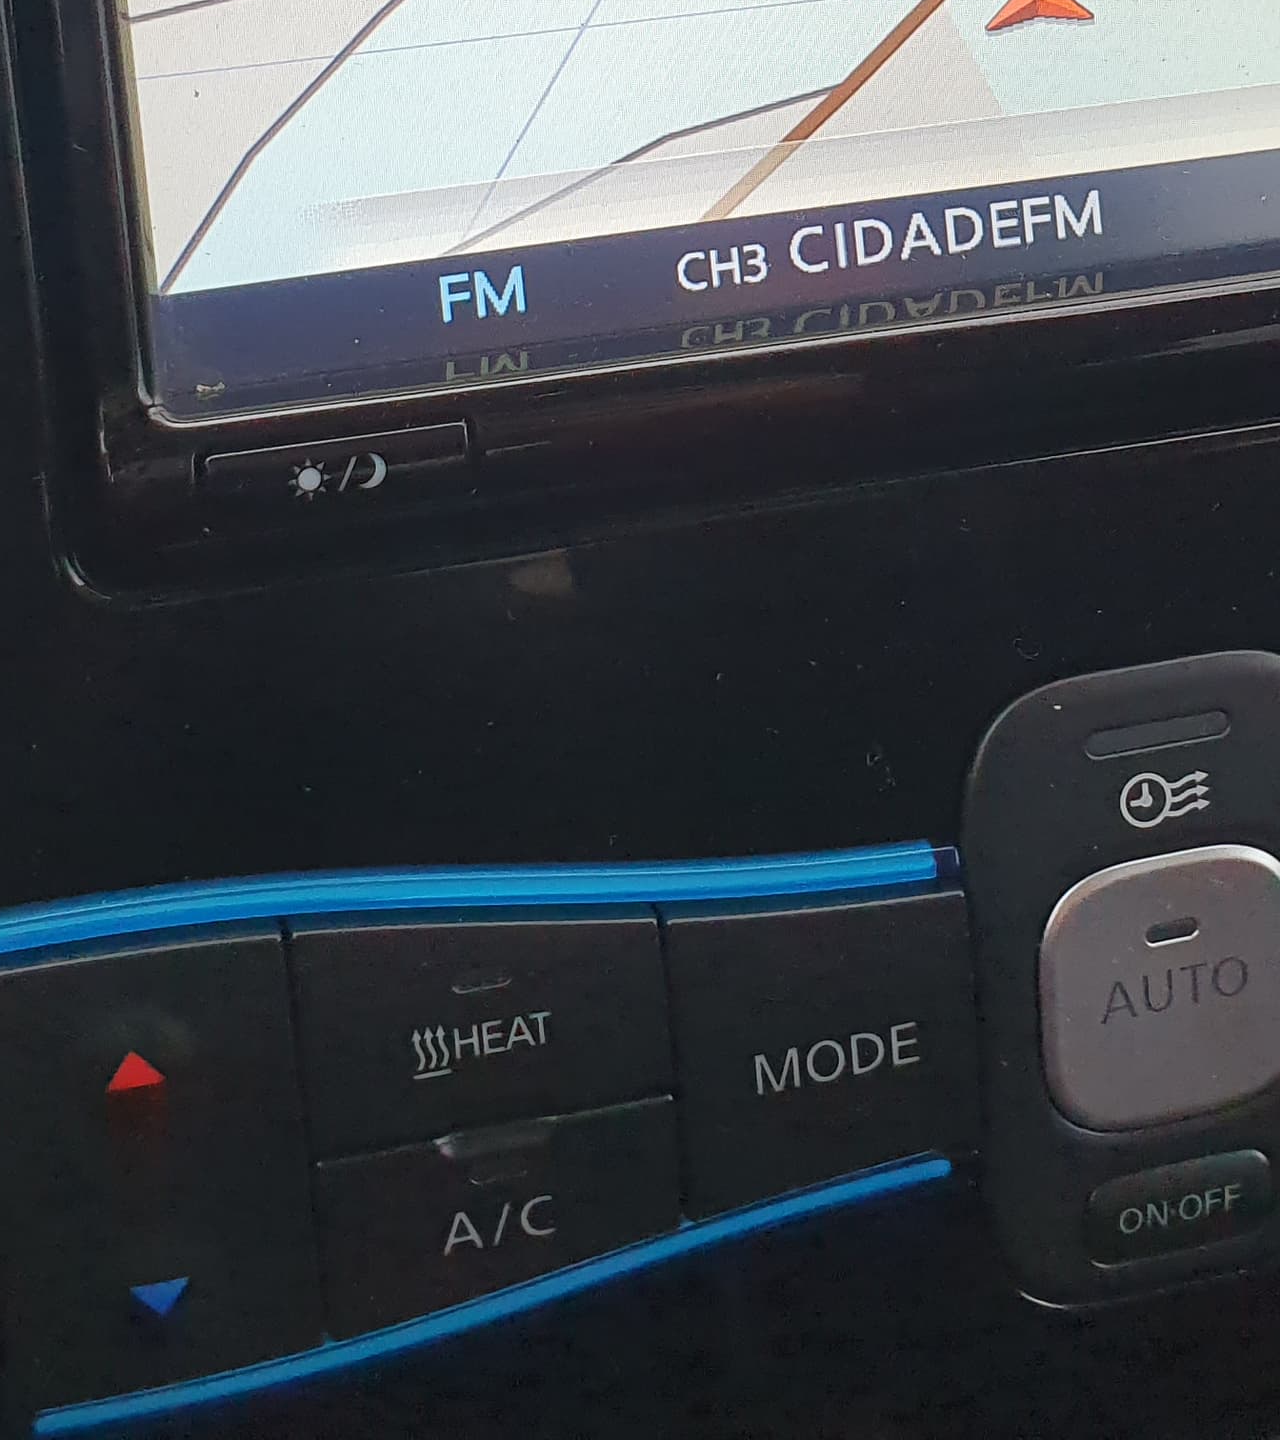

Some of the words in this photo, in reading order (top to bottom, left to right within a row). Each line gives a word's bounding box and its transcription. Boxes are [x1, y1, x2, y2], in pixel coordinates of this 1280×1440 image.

[437, 264, 527, 324] FM
[676, 243, 770, 294] CH3
[789, 188, 1104, 275] CIDADEFM
[1100, 955, 1250, 1026] AUTO
[452, 1010, 552, 1060] HEAT
[753, 1020, 922, 1096] MODE
[443, 1194, 557, 1257] A/C
